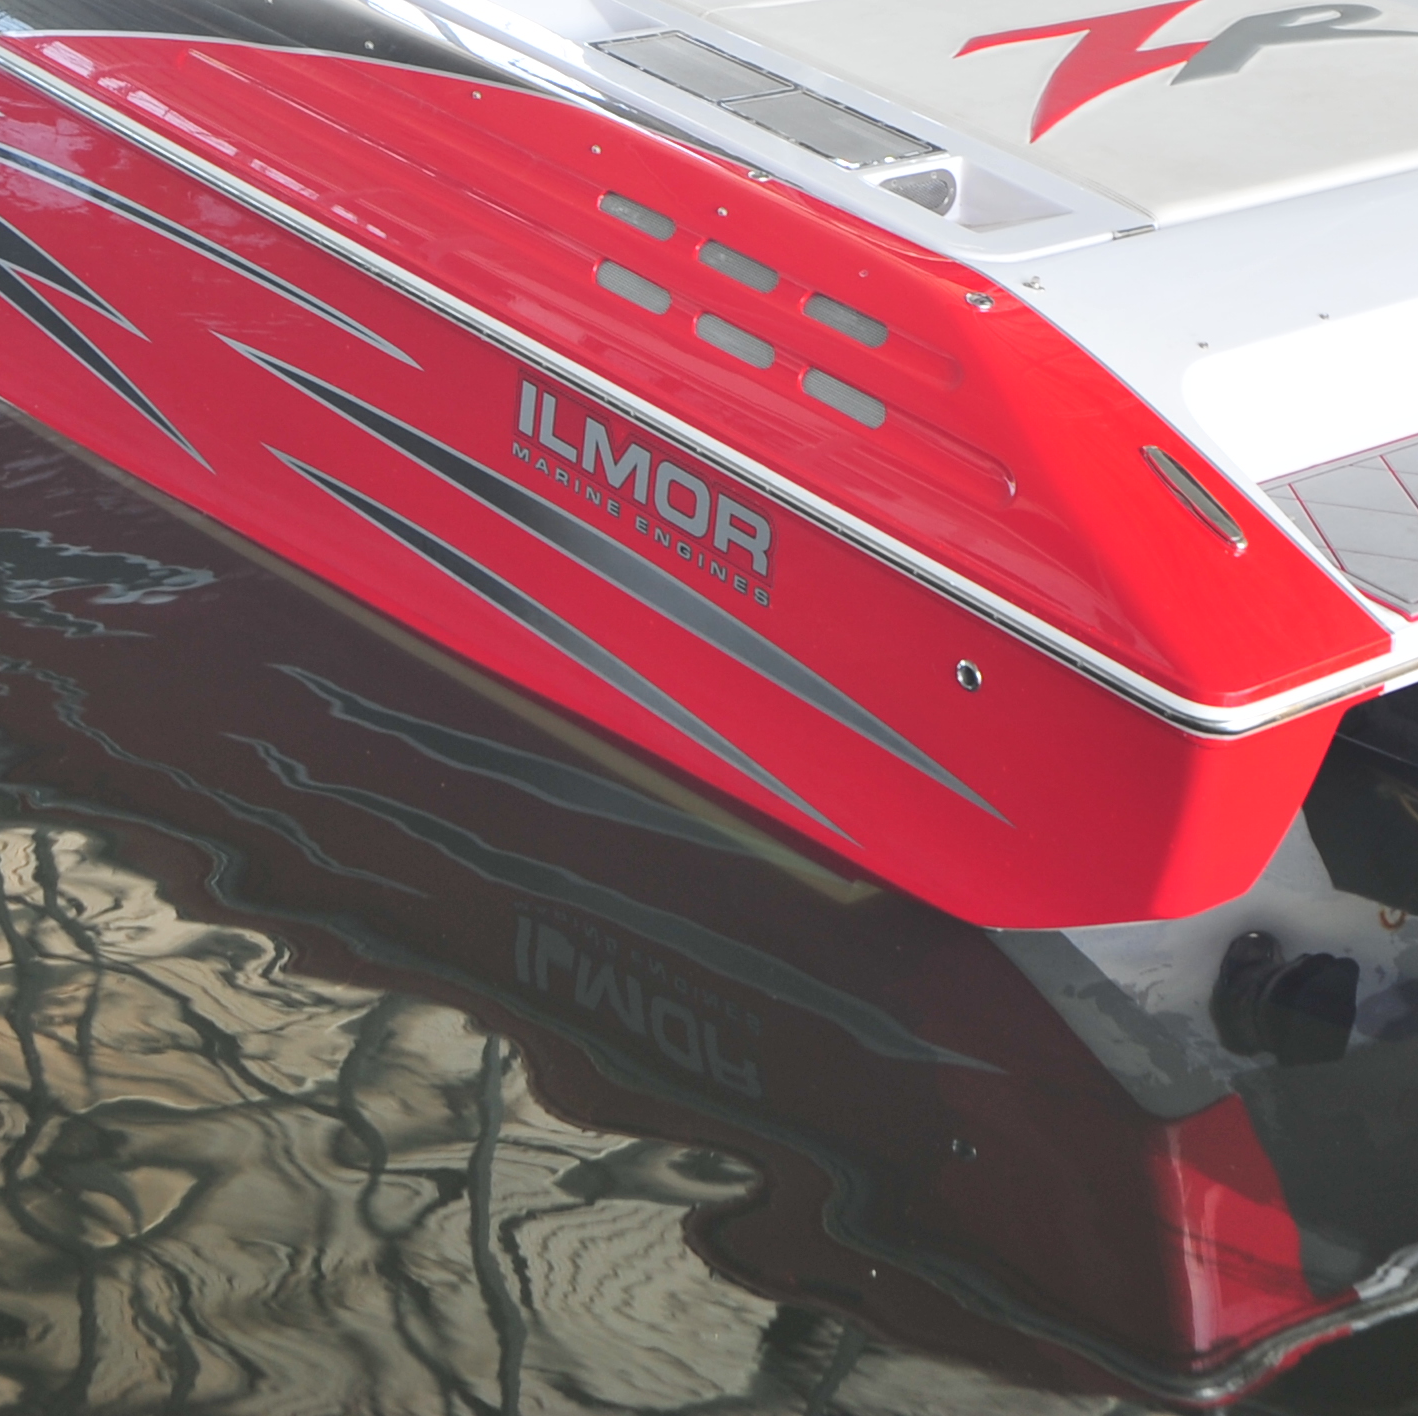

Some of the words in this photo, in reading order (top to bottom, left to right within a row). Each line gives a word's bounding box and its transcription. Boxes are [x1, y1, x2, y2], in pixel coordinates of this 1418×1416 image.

[511, 441, 621, 518] MARINE
[634, 514, 771, 607] ENGINES
[517, 379, 772, 577] ILMOR
